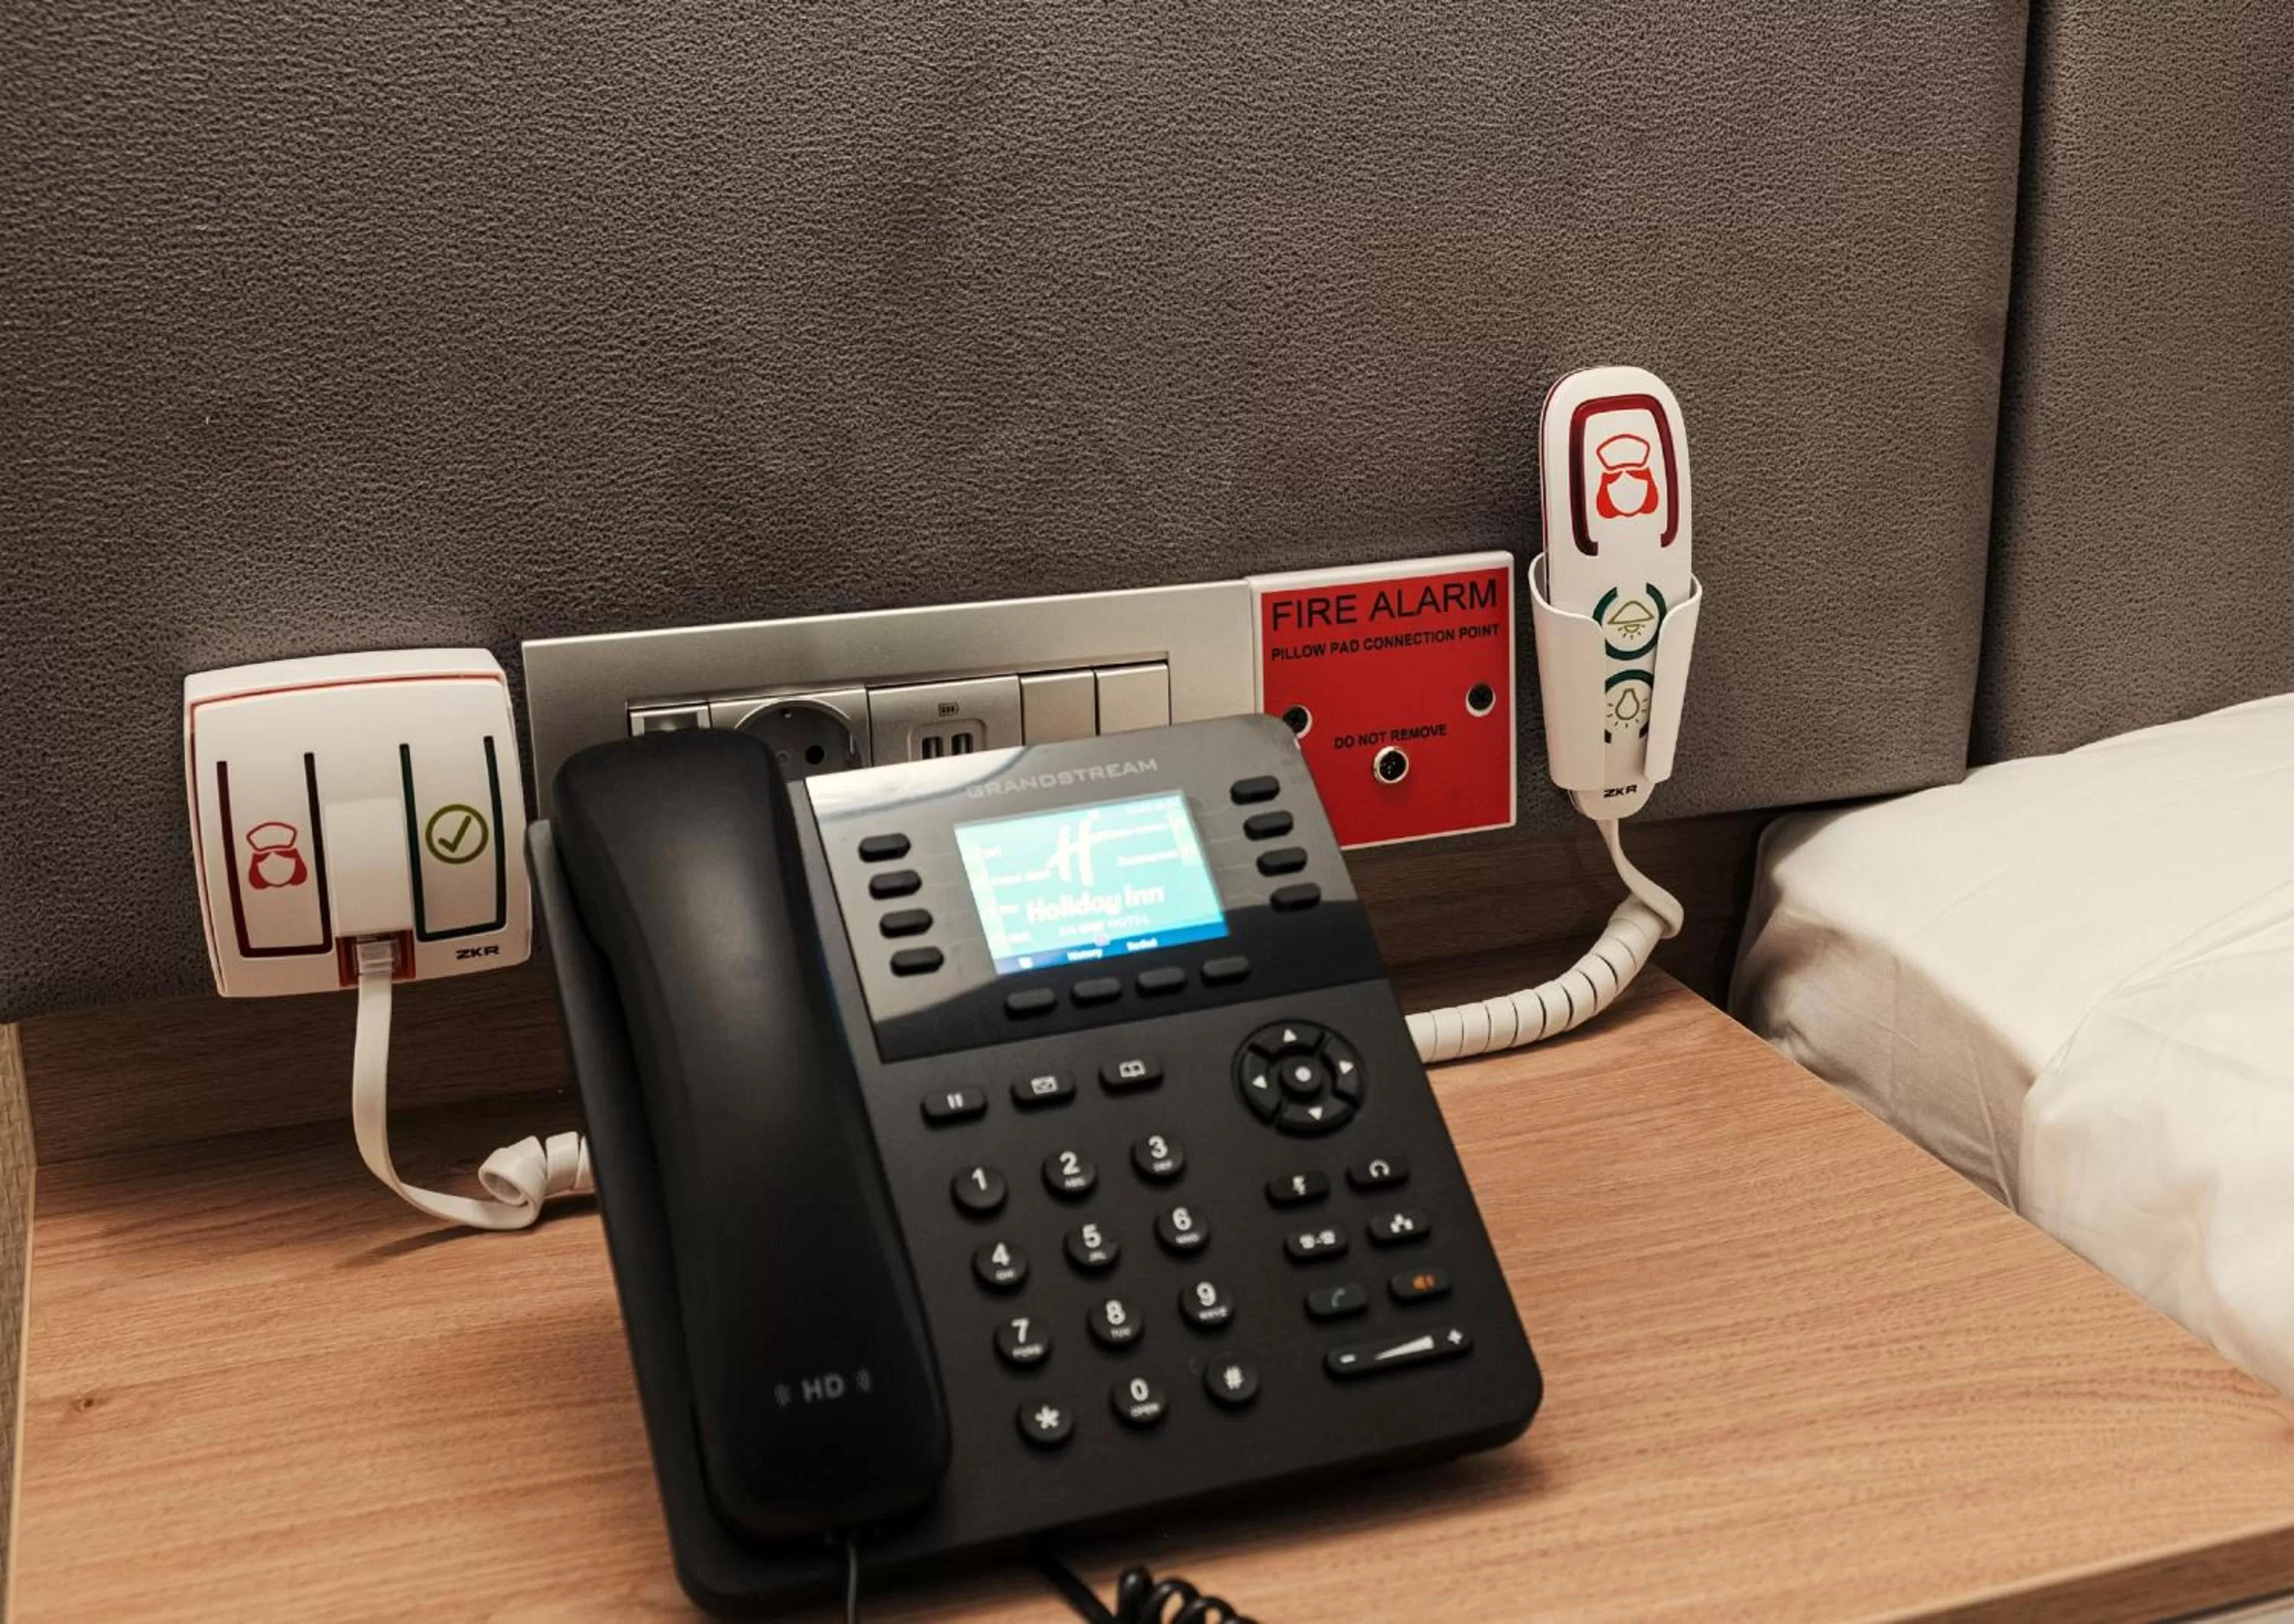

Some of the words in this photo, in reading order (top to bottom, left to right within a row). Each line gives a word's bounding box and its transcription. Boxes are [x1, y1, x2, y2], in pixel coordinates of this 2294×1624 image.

[1272, 593, 1357, 631] FIRE
[1369, 578, 1497, 621] ALARM
[1272, 641, 1325, 661] PILLOW
[1330, 638, 1360, 654] PAD
[1363, 628, 1454, 651] CONNECTION
[1459, 623, 1500, 640] POINT
[1334, 736, 1354, 749] DO
[1358, 732, 1386, 747] NOT
[1390, 724, 1448, 742] REMOVE
[966, 758, 1158, 799] GRANDSTREAM
[1025, 888, 1123, 924] Holiday
[1124, 884, 1166, 908] Inn
[455, 945, 500, 960] ZKR
[1148, 1135, 1168, 1159] 3
[1059, 1151, 1080, 1175] 2
[971, 1167, 987, 1190] 1
[1172, 1207, 1192, 1231] 6
[1082, 1223, 1102, 1249] 5
[992, 1242, 1010, 1266] 4
[1196, 1281, 1217, 1307] 9
[1106, 1300, 1126, 1325] 8
[1011, 1318, 1030, 1343] 7
[801, 1373, 846, 1402] HD
[1130, 1378, 1149, 1402] 0
